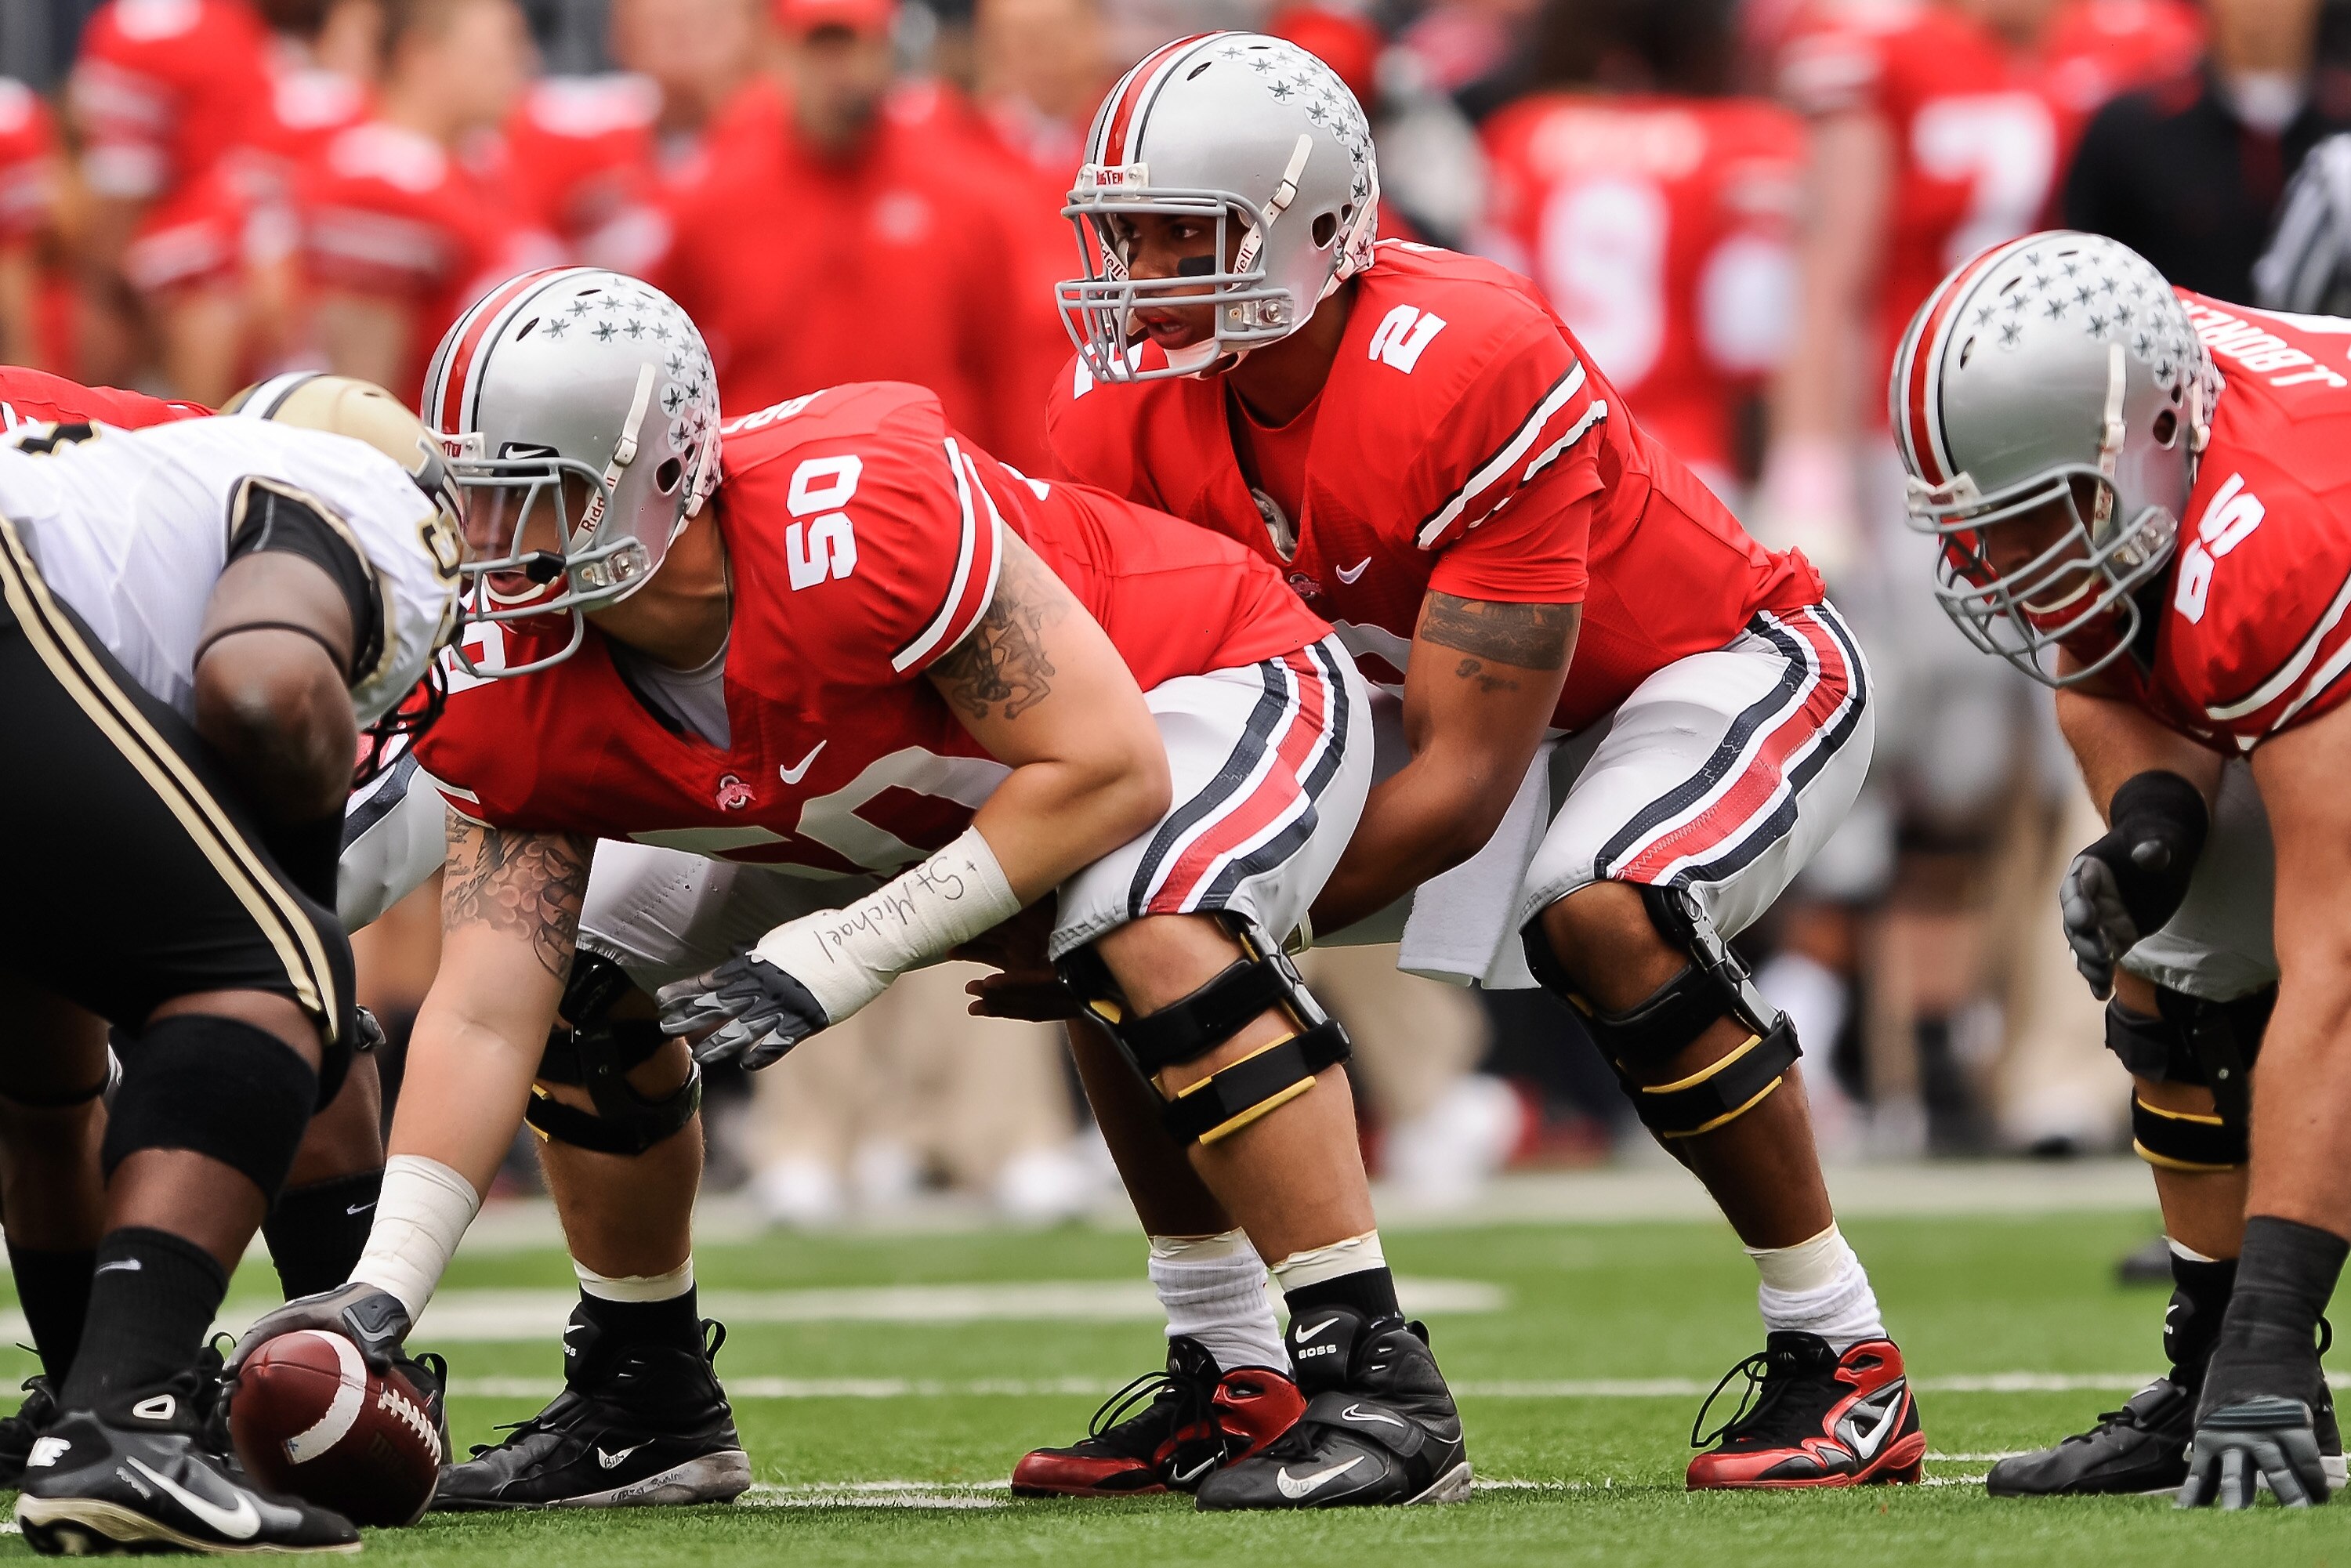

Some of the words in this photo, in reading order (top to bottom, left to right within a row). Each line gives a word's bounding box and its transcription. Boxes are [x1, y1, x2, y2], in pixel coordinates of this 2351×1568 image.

[1909, 92, 2059, 274] 7
[1368, 303, 1447, 375] 2
[580, 476, 617, 533] Riddll
[785, 454, 864, 592] 50
[2174, 471, 2266, 625] 65
[813, 881, 917, 965] Michael
[1298, 1344, 1337, 1360] BOSS
